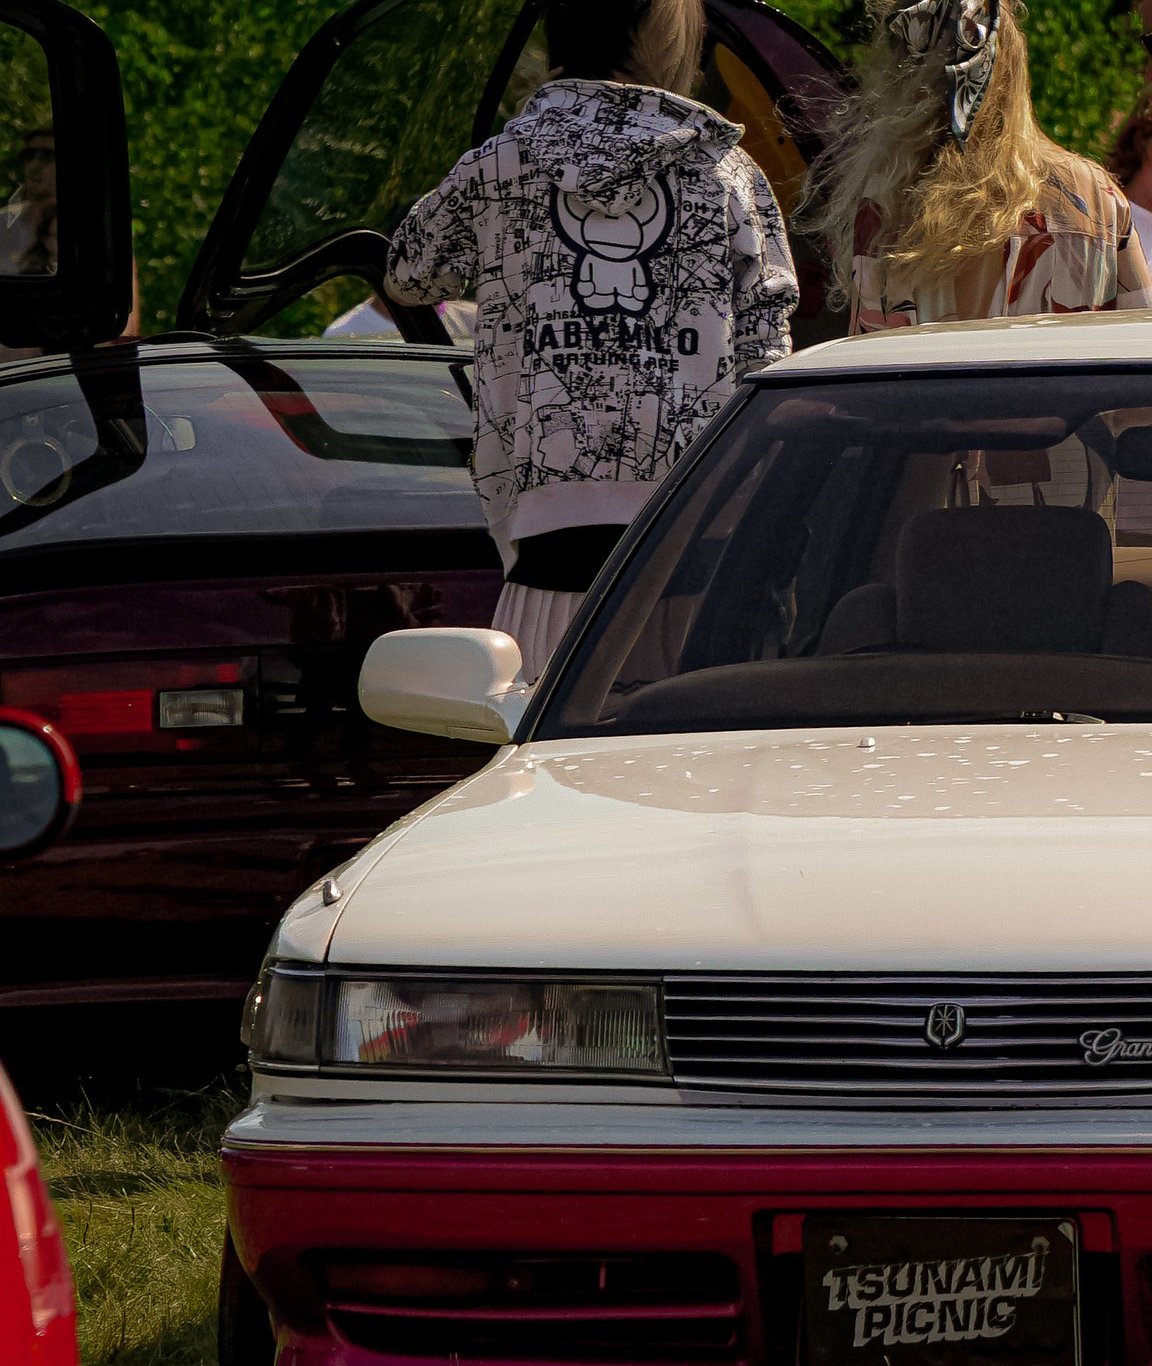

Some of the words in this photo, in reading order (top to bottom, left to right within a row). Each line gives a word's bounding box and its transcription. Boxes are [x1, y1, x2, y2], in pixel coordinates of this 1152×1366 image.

[523, 321, 608, 357] BABY
[617, 322, 699, 356] MILO
[552, 352, 642, 370] BATHING
[646, 357, 680, 373] APE
[823, 1251, 1049, 1311] TSUNAMI
[853, 1295, 1017, 1347] PICNIC
